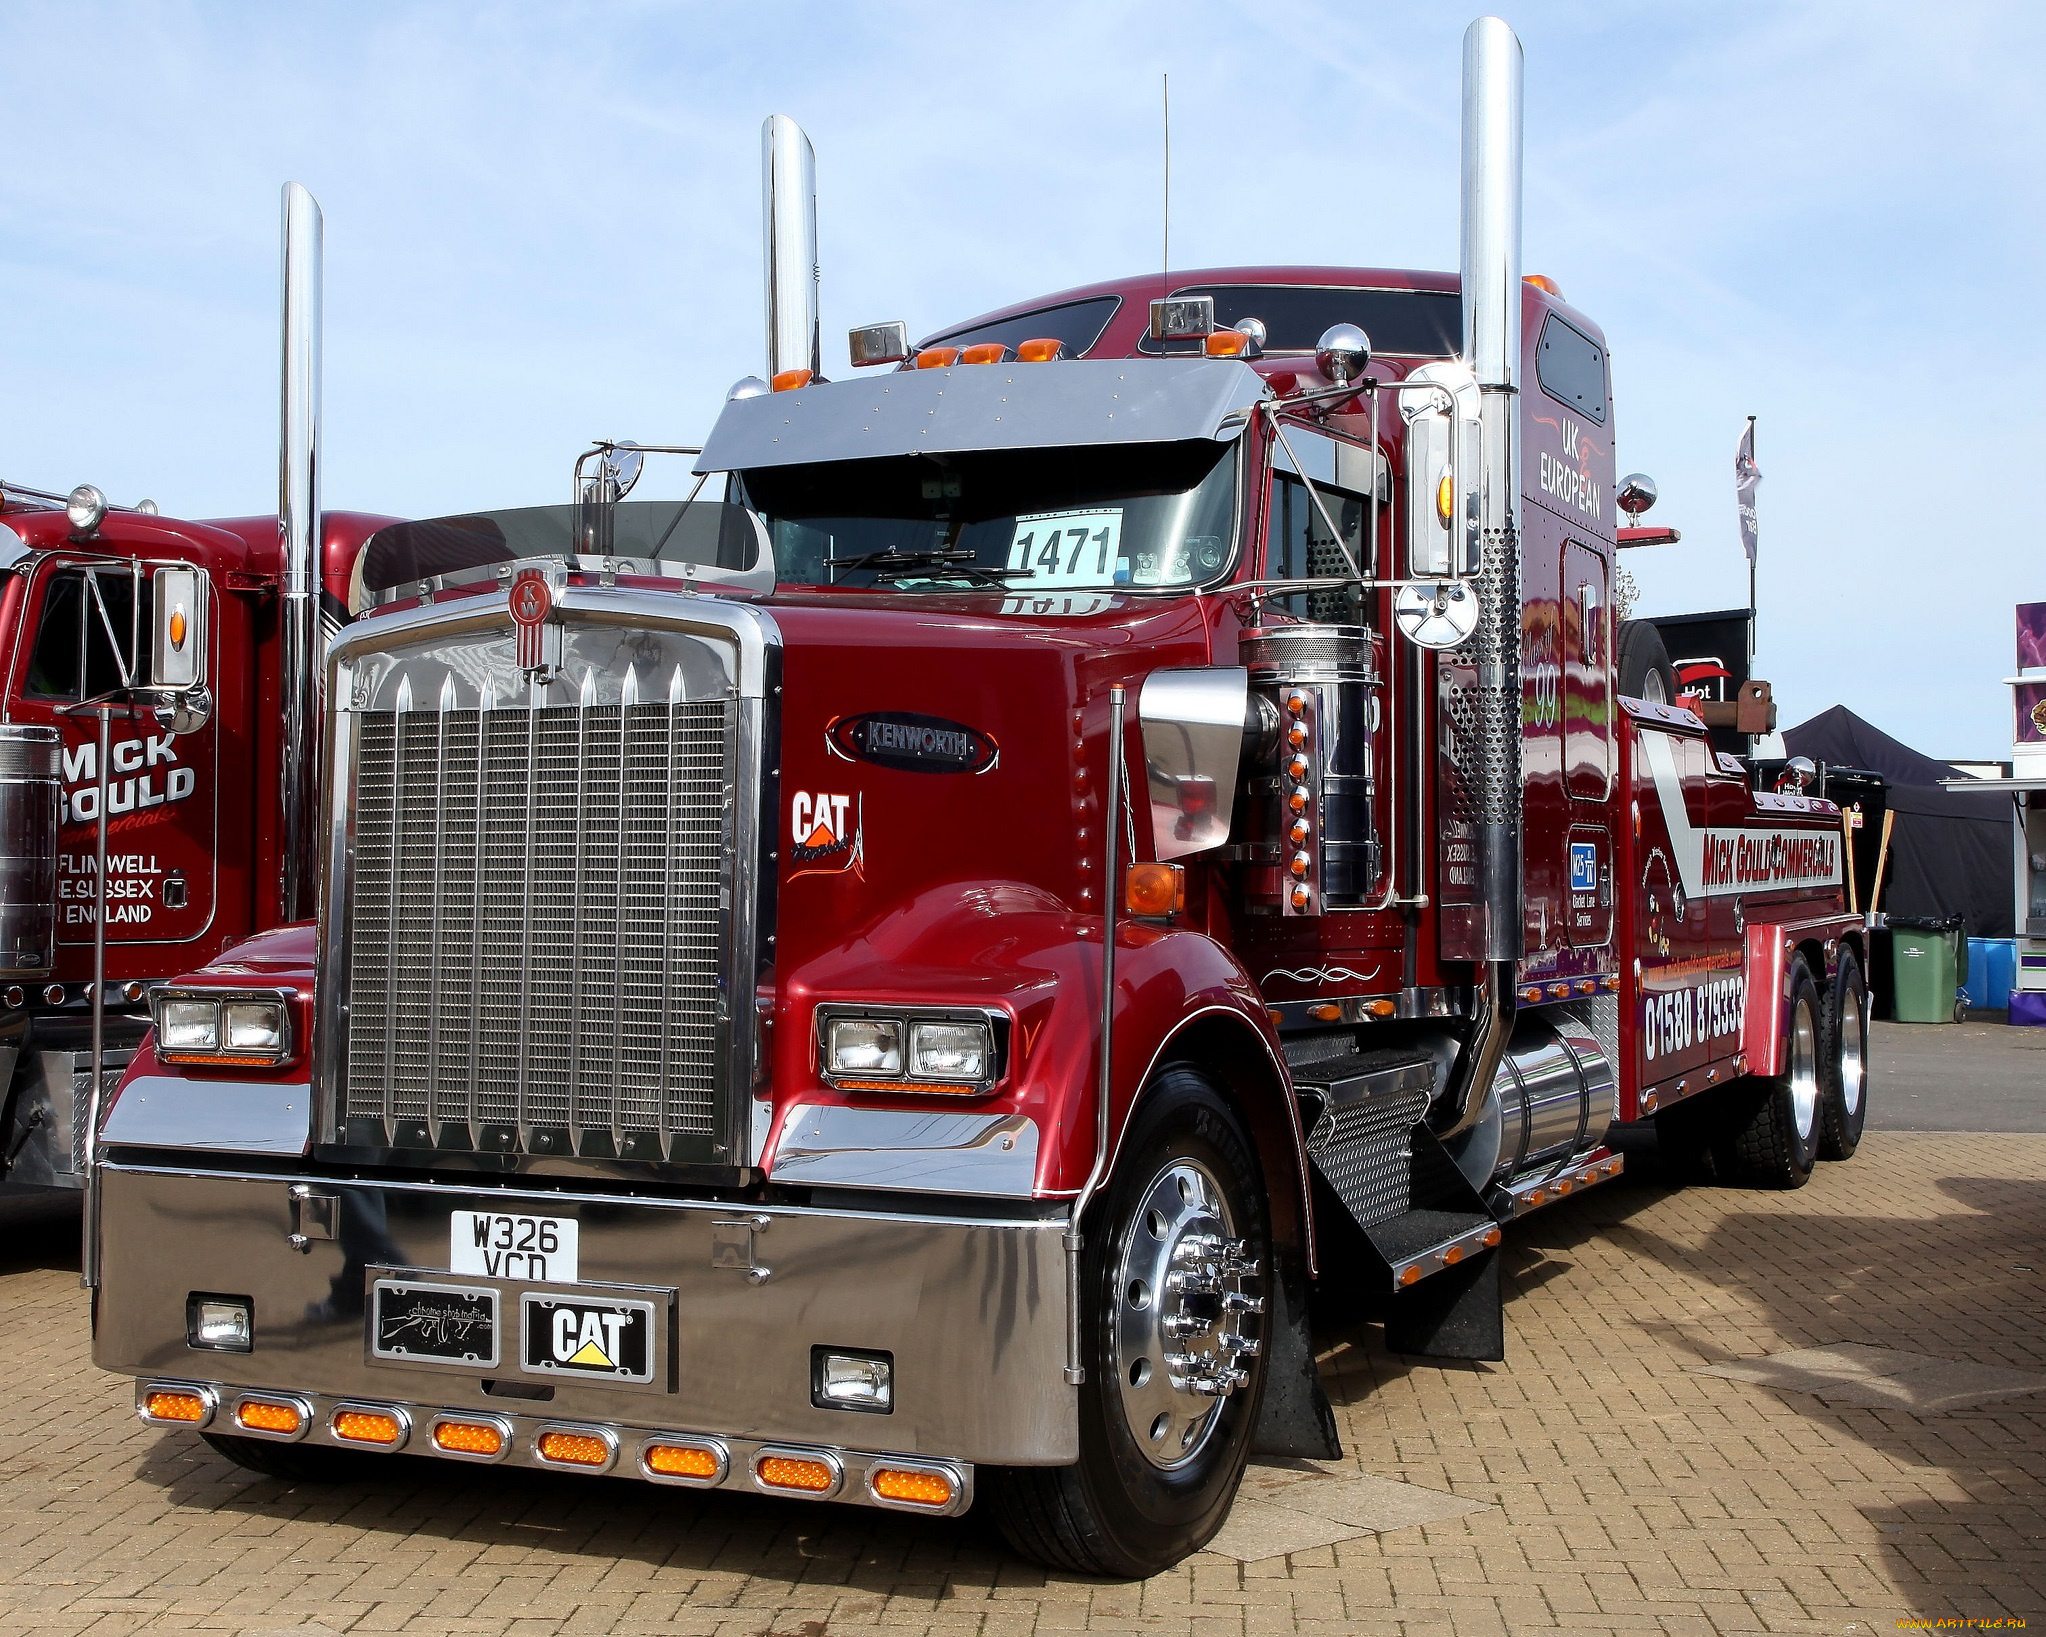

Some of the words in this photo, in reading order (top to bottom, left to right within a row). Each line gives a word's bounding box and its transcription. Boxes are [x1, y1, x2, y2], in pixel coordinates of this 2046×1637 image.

[1562, 417, 1579, 461] UK
[1540, 451, 1600, 520] EUROPEAN
[1017, 527, 1110, 574] 1471
[1535, 662, 1556, 728] 99
[62, 733, 178, 783] MCK
[868, 721, 967, 756] KENWORTH
[792, 790, 850, 844] CAT
[1572, 854, 1585, 878] M25
[1702, 834, 1735, 886] MICK
[1736, 834, 1771, 883] GOULD
[1645, 997, 1692, 1061] 01580
[1697, 976, 1744, 1043] 879333
[472, 1214, 559, 1254] W326
[552, 1308, 627, 1367] CAT
